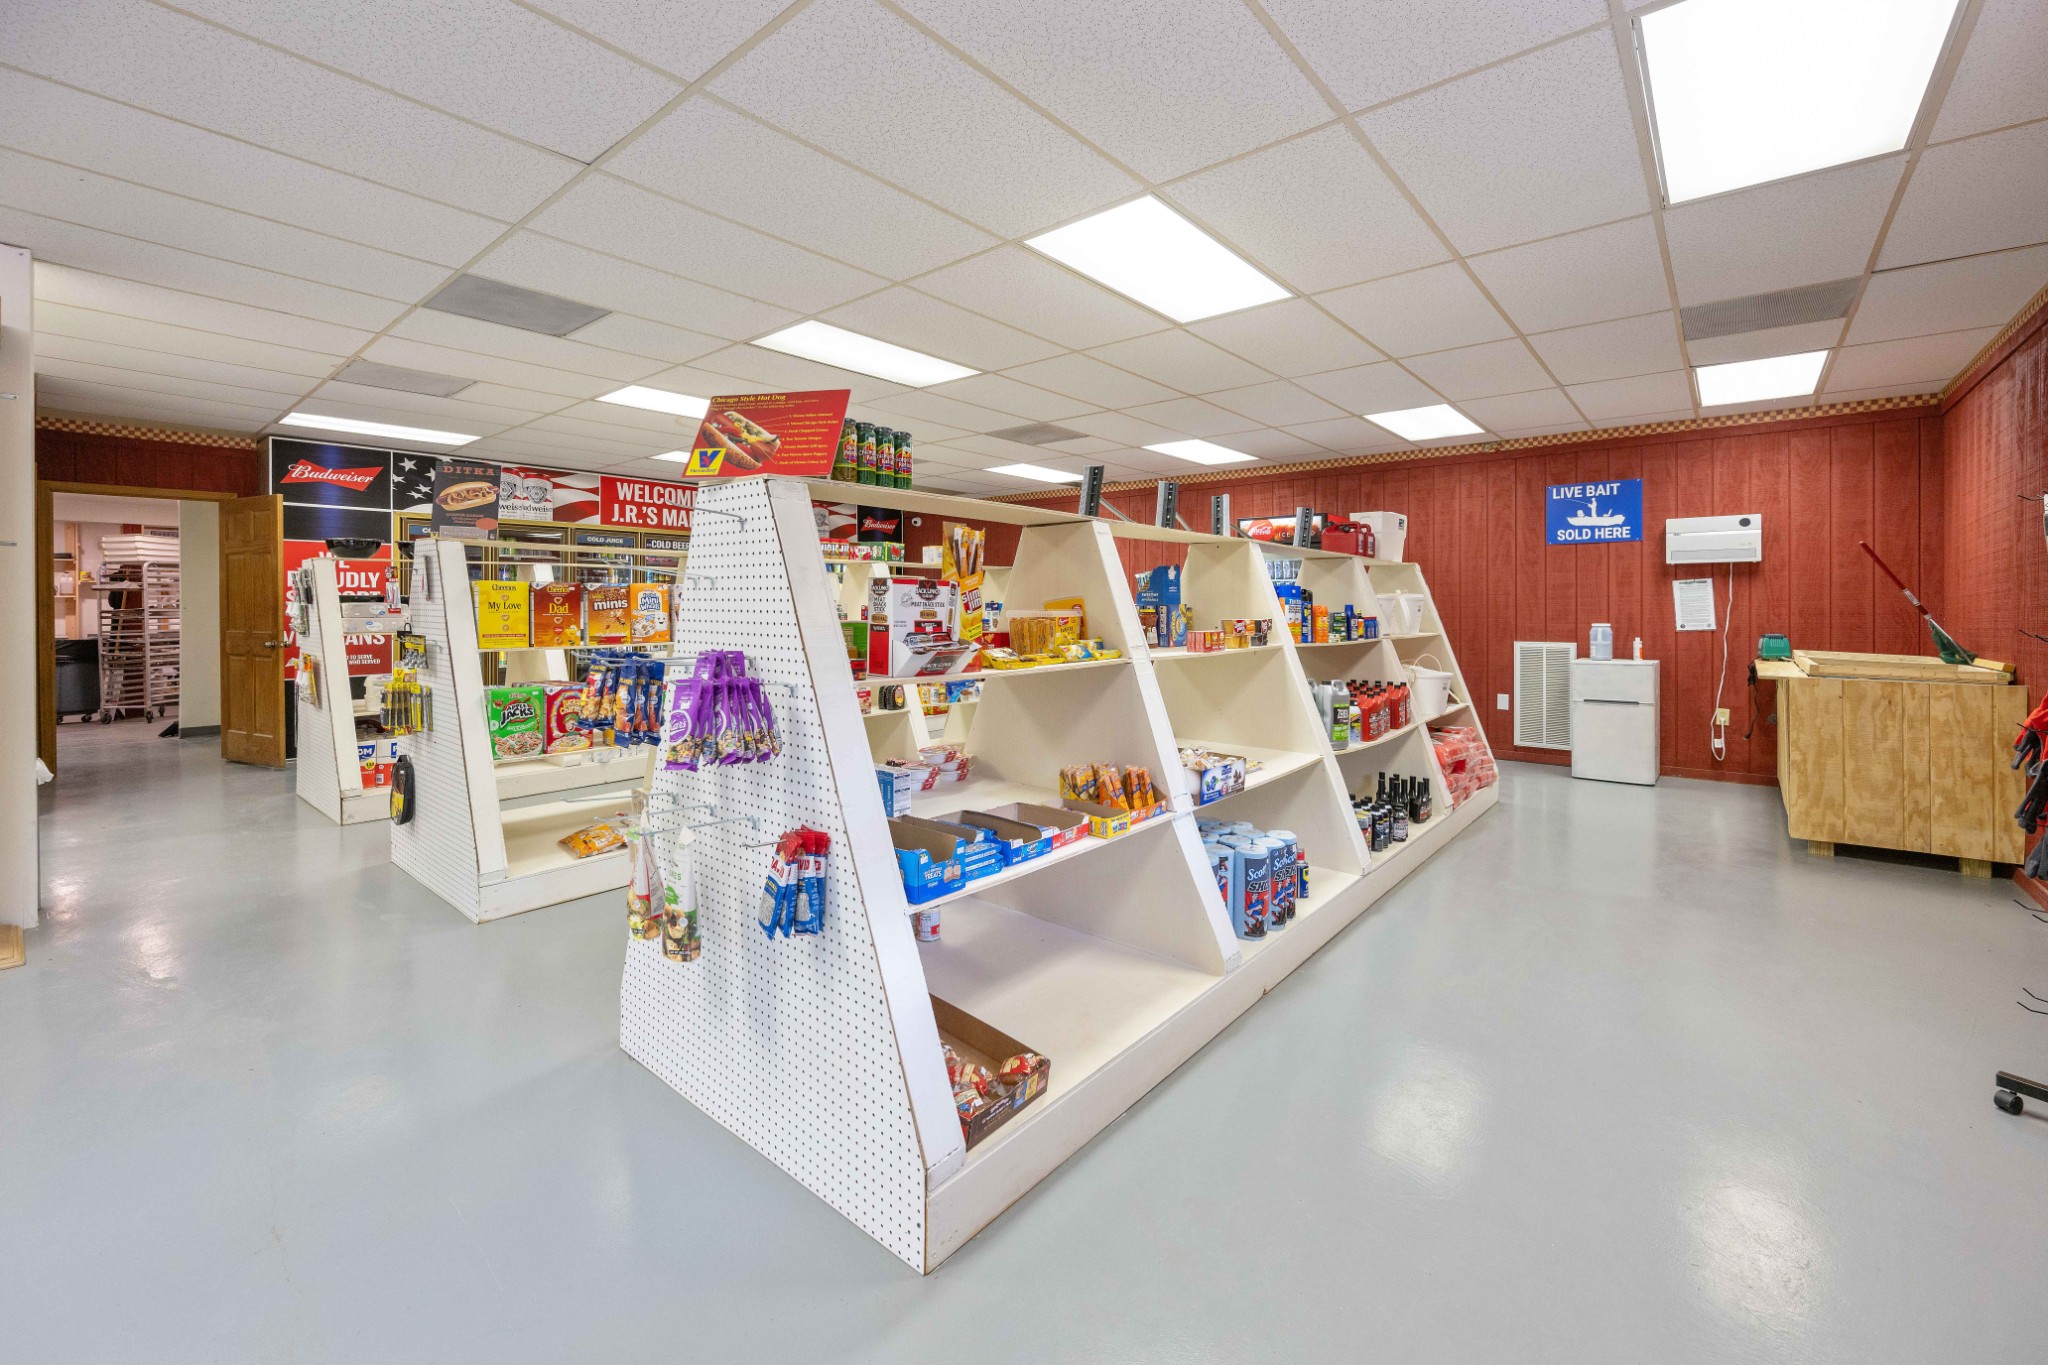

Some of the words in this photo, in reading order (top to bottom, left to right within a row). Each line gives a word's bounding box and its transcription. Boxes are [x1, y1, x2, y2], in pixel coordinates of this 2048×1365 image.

[771, 394, 786, 402] Dog
[288, 464, 374, 482] Budweiser
[443, 465, 495, 475] DITKA
[1552, 486, 1583, 500] LIVE
[1586, 483, 1620, 497] BAIT
[611, 503, 657, 525] J.R.'S
[662, 508, 694, 527] MA
[863, 519, 896, 530] Budweiser
[1557, 528, 1591, 541] SOLD
[1595, 526, 1631, 540] HERE
[651, 540, 671, 549] COLD
[487, 602, 501, 614] My
[503, 601, 522, 610] Love
[549, 603, 569, 614] Dad
[593, 599, 628, 611] minis
[501, 708, 534, 727] JACKS
